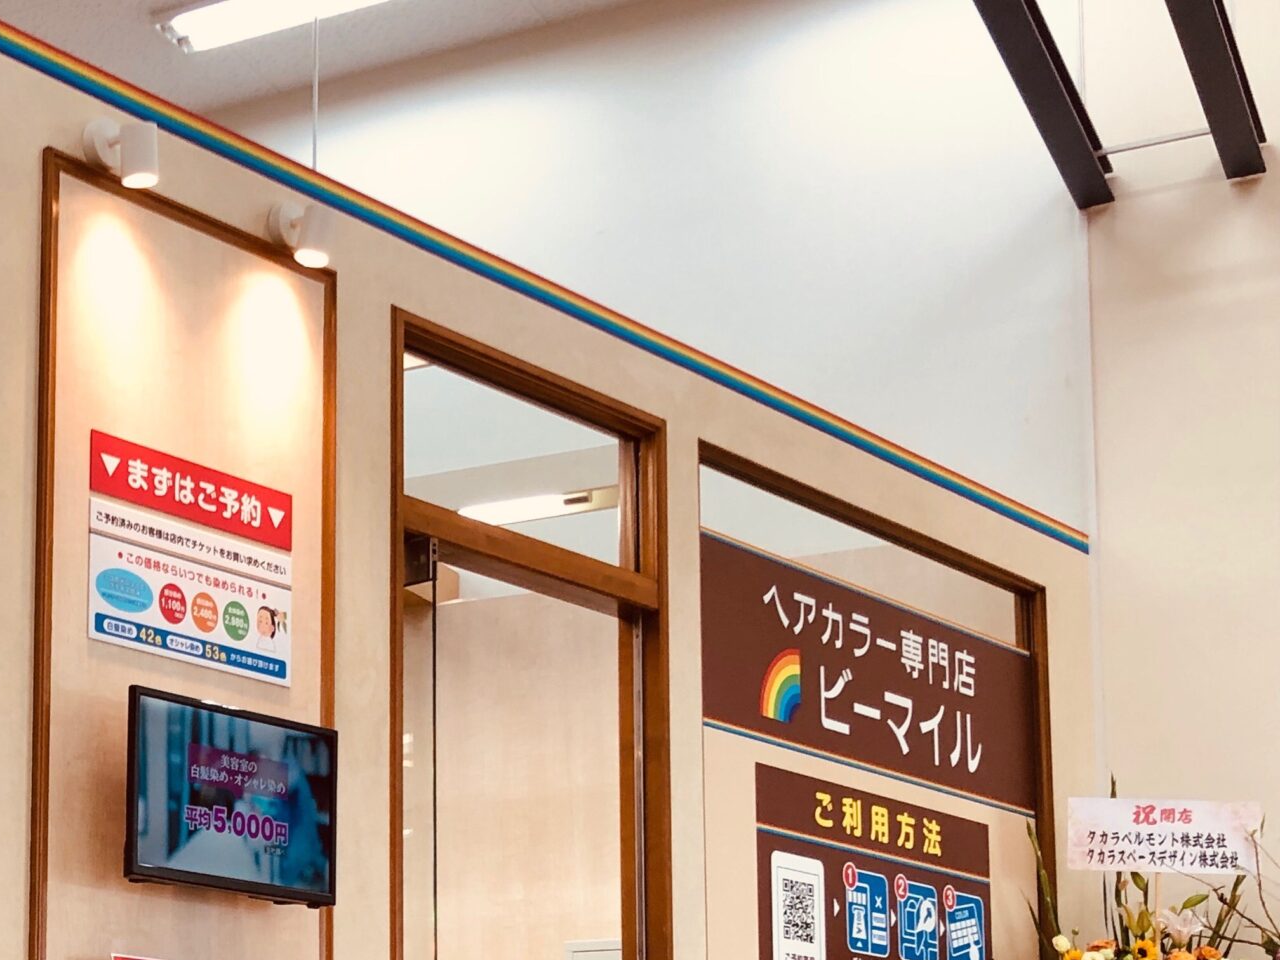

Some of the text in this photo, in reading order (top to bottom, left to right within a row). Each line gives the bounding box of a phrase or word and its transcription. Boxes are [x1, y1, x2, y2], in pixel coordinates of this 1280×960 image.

[128, 459, 262, 528] まずはご予約
[762, 585, 976, 697] ヘアカラー専門店
[820, 665, 982, 773] ビーマイル
[185, 805, 288, 845] 平均5,000円
[815, 791, 942, 857] ご利用方法
[1086, 830, 1228, 849] タカラベルモント株式会社
[1086, 849, 1239, 869] タカラスペースデザイン株式会社
